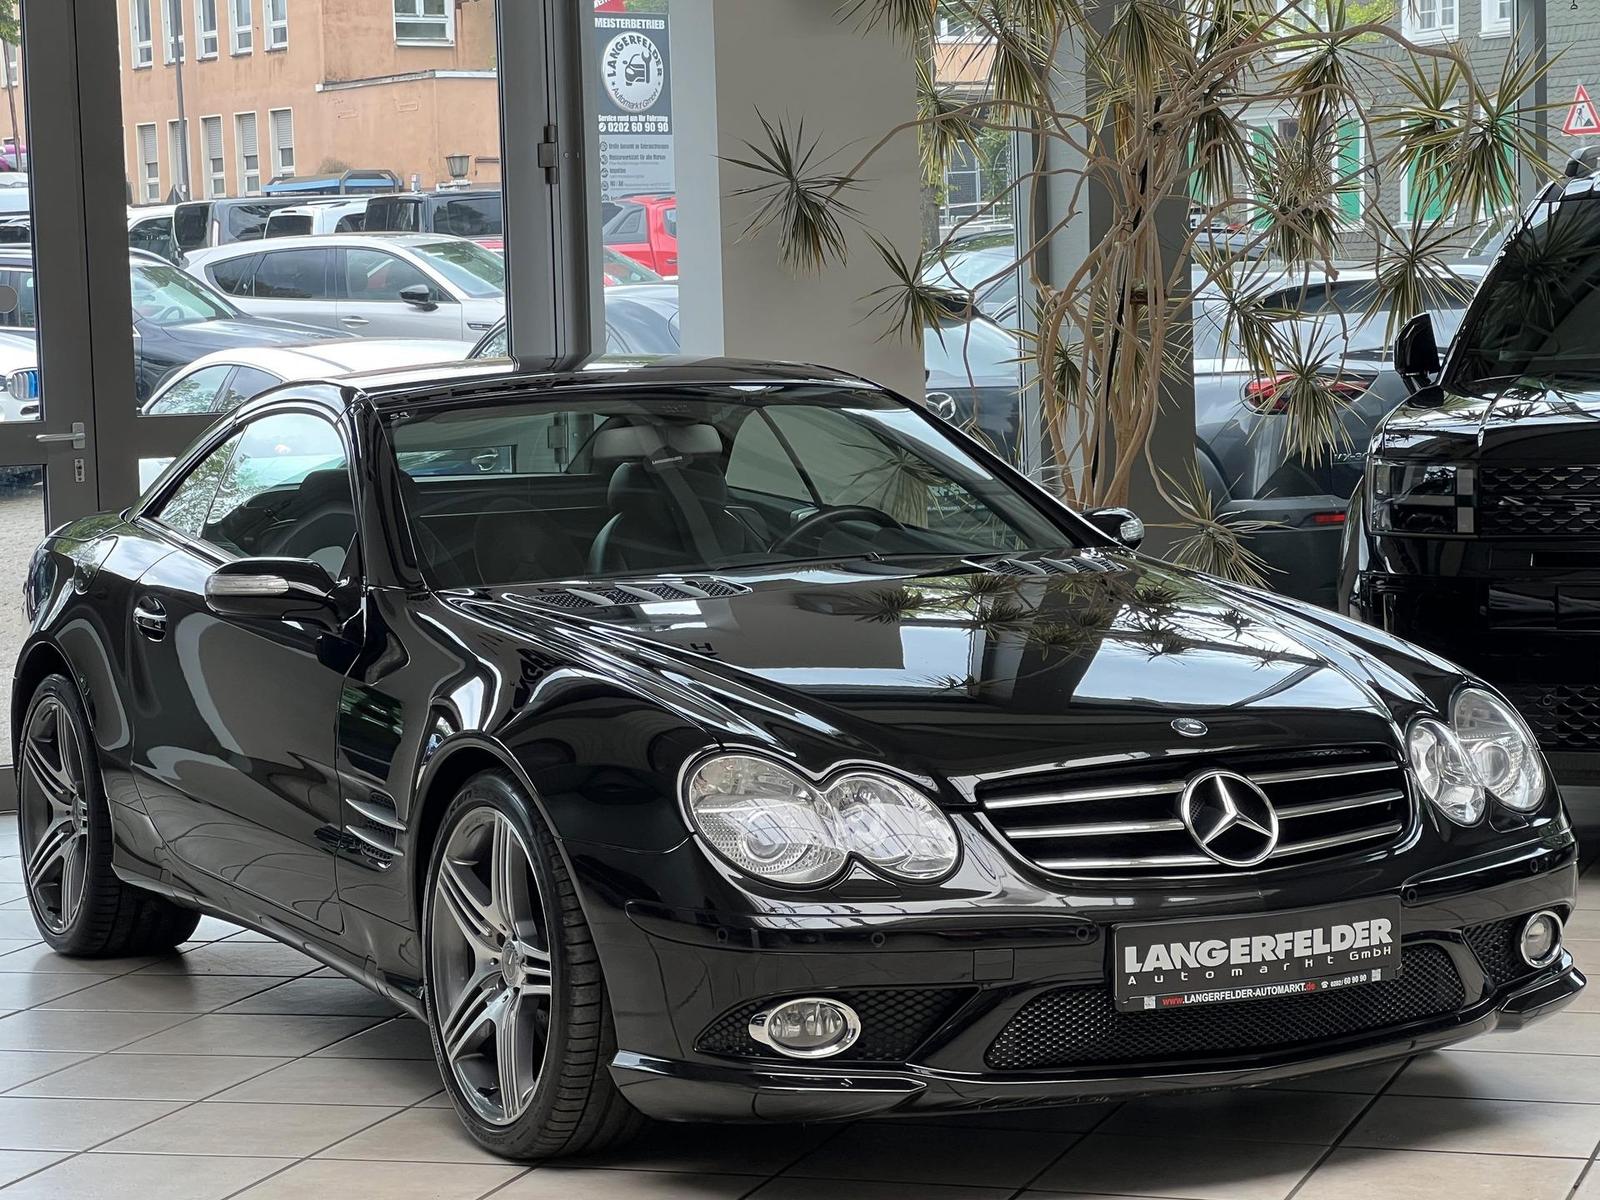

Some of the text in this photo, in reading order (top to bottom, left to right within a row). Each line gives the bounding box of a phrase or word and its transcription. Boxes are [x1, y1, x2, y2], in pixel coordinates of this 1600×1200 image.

[594, 18, 665, 29] MEISTERBETRIEB
[607, 34, 663, 78] LANGERFELDER
[612, 87, 659, 110] Automarkt GmbH
[608, 122, 669, 133] 0202 60 90 90
[1124, 917, 1393, 974] LANGERFELDER
[1349, 945, 1392, 961] GmbH
[1351, 975, 1359, 984] 90
[1359, 973, 1367, 982] 90
[1161, 982, 1318, 1006] www.LANGERFELDER-AUTOMARKT.de
